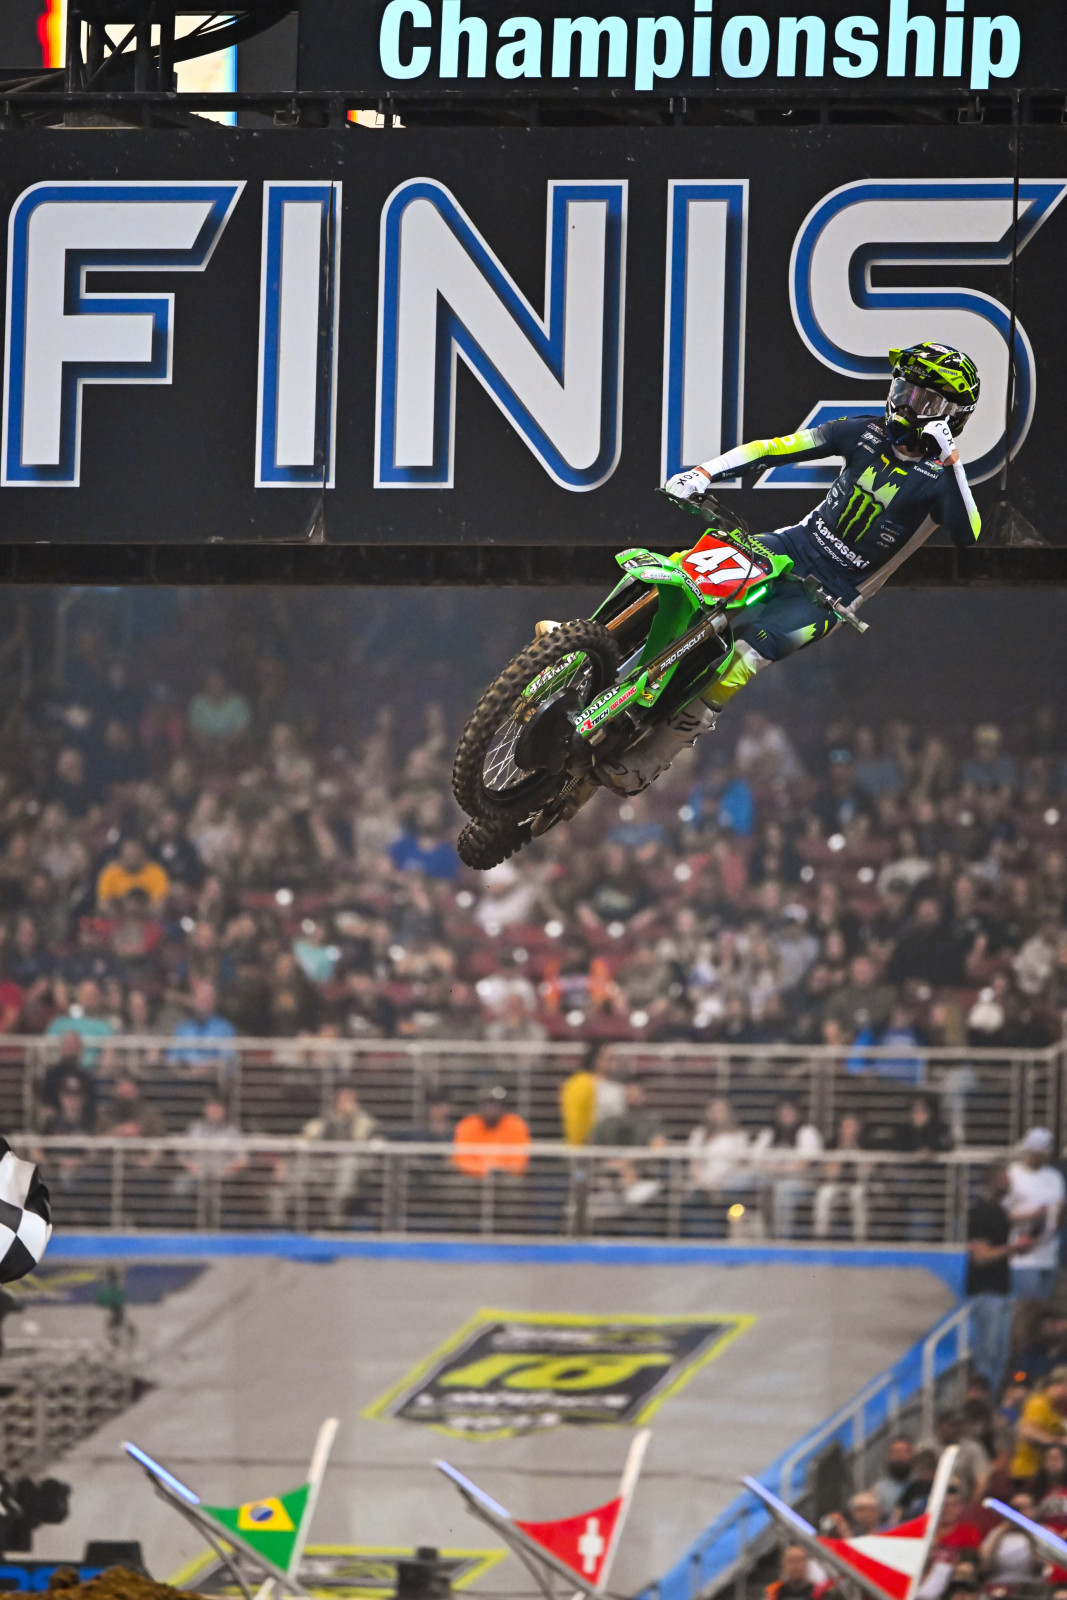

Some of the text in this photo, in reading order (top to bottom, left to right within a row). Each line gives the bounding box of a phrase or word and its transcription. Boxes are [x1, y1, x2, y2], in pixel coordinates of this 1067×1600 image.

[380, 0, 1021, 90] Championship
[677, 471, 700, 486] FOX
[913, 465, 939, 479] Kawasaki
[815, 517, 870, 569] Kawasaki
[684, 546, 763, 586] 47
[660, 629, 706, 671] PRO CIRCUIT
[574, 685, 621, 726] DUNLOP
[610, 685, 637, 712] BRAKING
